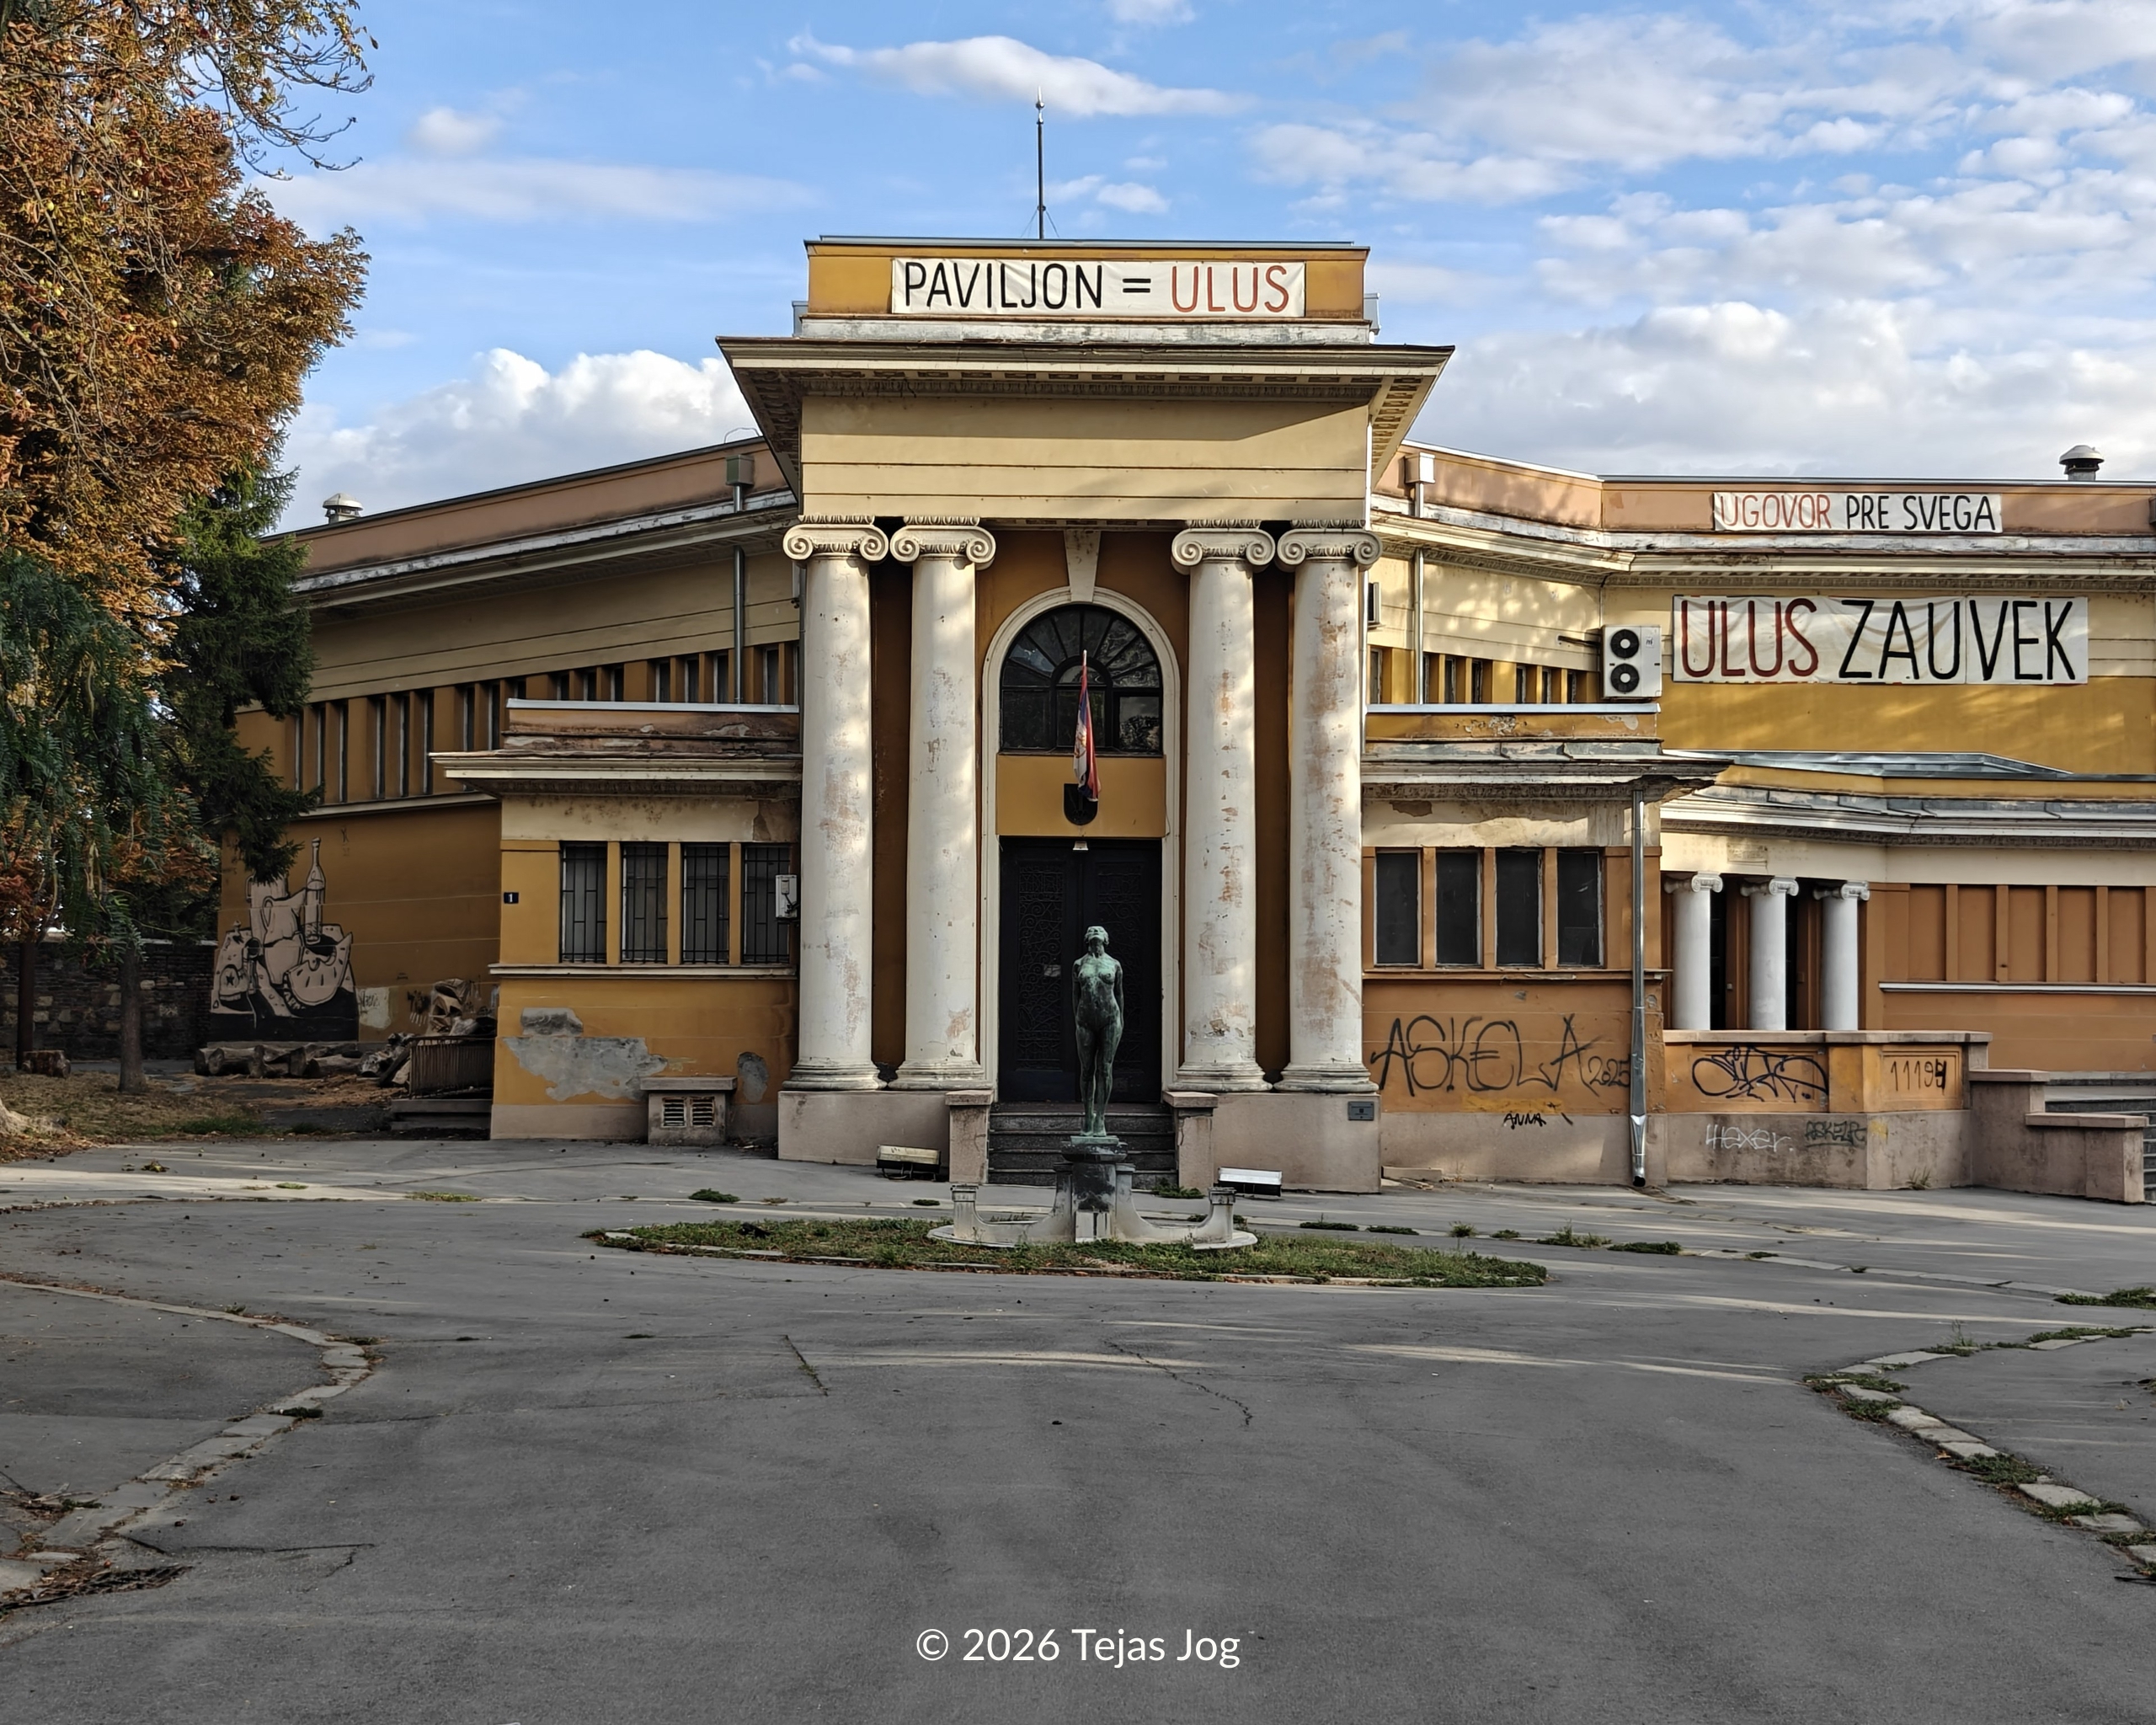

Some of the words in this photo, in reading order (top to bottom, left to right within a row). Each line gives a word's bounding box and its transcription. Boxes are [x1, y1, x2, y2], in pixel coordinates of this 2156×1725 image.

[905, 262, 1102, 310] PAVILJON
[1171, 265, 1290, 313] ULUS
[1719, 494, 1833, 529] UGOVOR
[1846, 494, 1891, 530] PRE
[1902, 494, 1997, 531] SVEGA
[1681, 598, 1819, 678] ULUS
[1838, 599, 2076, 681] ZAUVEK
